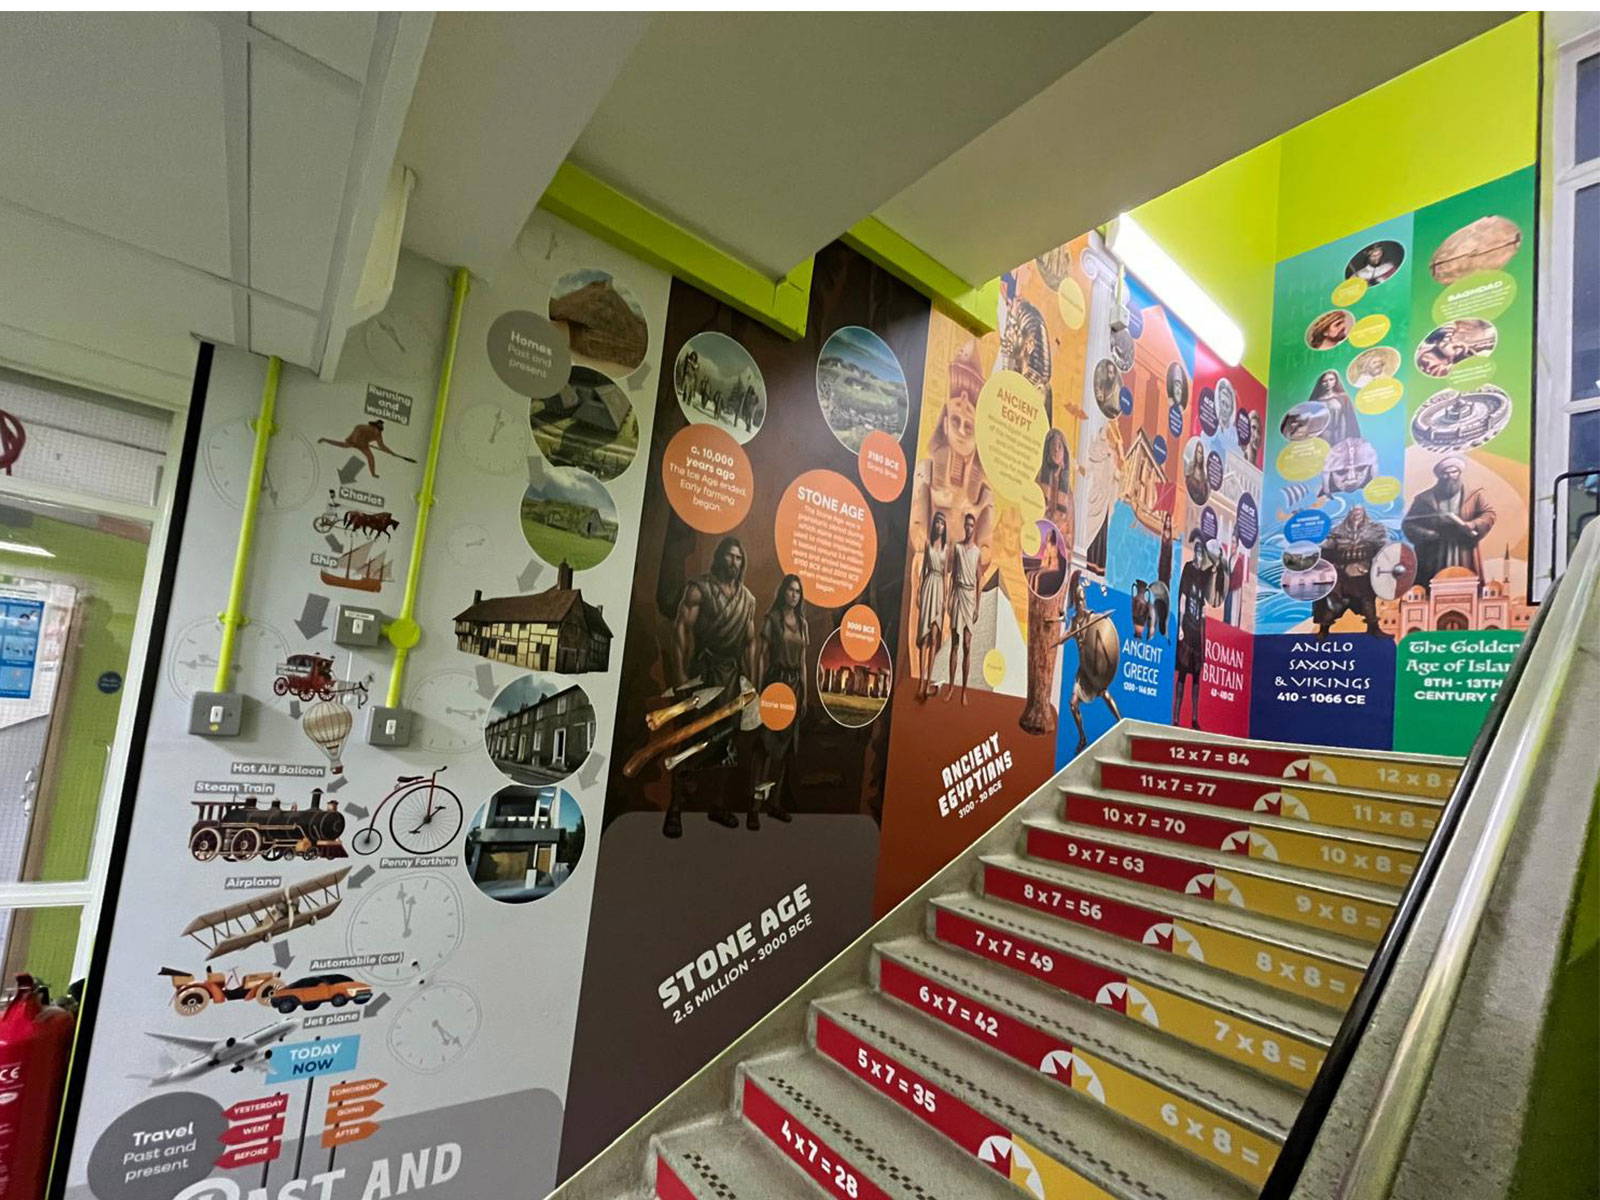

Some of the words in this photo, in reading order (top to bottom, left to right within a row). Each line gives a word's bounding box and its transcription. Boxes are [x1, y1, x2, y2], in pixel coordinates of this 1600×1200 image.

[511, 331, 552, 356] Homes
[509, 359, 547, 378] present
[378, 400, 399, 410] and
[996, 388, 1038, 421] ANCIENT
[1002, 406, 1032, 432] EGYPT
[686, 457, 714, 473] years
[716, 468, 735, 480] ago
[702, 448, 734, 467] 10,000
[669, 462, 685, 475] The
[687, 469, 700, 480] Ice
[701, 475, 718, 487] Age
[341, 488, 383, 505] Chariot
[680, 479, 702, 494] Early
[703, 486, 735, 506] farming
[797, 486, 839, 512] STONE
[840, 502, 865, 521] AGE
[312, 555, 337, 567] Ship
[1122, 639, 1163, 664] ANCIENT
[1205, 639, 1244, 669] ROMAN
[1291, 642, 1353, 653] ANGLO
[1409, 640, 1446, 653] The
[1123, 662, 1159, 685] GREECE
[1289, 659, 1355, 671] SAXONS
[1406, 659, 1440, 676] Age
[1443, 659, 1465, 672] of
[1202, 663, 1244, 691] BRITAIN
[1275, 676, 1288, 687] &
[1291, 676, 1370, 689] VIKINGS
[1424, 678, 1452, 687] 8TH
[1466, 678, 1503, 688] 13TH
[1277, 692, 1299, 702] 410
[1310, 693, 1342, 703] 1066
[1344, 694, 1366, 704] CE
[1414, 690, 1487, 702] CENTURY
[941, 731, 1000, 789] ANCIENT
[1169, 747, 1185, 759] 12
[1189, 750, 1198, 761] x
[1202, 750, 1211, 761] 7
[1228, 752, 1249, 766] 84
[232, 763, 255, 774] Hot
[259, 764, 276, 775] Air
[279, 766, 324, 776] Balloon
[1378, 768, 1400, 783] 12
[1427, 773, 1441, 787] 8
[196, 782, 240, 793] Steam
[244, 783, 274, 793] Train
[938, 750, 1013, 818] EGYPTIANS
[1140, 775, 1153, 787] 11
[1157, 779, 1167, 790] x
[1171, 779, 1180, 791] 7
[1197, 782, 1216, 796] 77
[958, 801, 975, 818] 3100
[988, 779, 1003, 797] BCE
[1103, 807, 1119, 822] 10
[1124, 813, 1133, 825] x
[1137, 813, 1147, 826] 7
[1164, 817, 1186, 834] 70
[1353, 804, 1372, 821] 11
[1400, 811, 1415, 828] 8
[381, 858, 413, 869] Penny
[415, 857, 457, 868] Farthing
[1067, 843, 1077, 857] 9
[1081, 850, 1091, 862] x
[1095, 849, 1105, 863] 7
[1122, 856, 1145, 873] 63
[1320, 845, 1346, 864] 10
[1375, 855, 1391, 872] 8
[226, 877, 280, 888] Airplane
[1024, 884, 1034, 899] 8
[1038, 890, 1048, 904] x
[1052, 892, 1061, 906] 7
[1079, 900, 1102, 920] 56
[1296, 895, 1312, 912] 9
[1341, 905, 1358, 925] 8
[657, 922, 757, 1010] STONE
[760, 883, 811, 937] AGE
[975, 929, 985, 946] 7
[988, 938, 999, 953] x
[1002, 940, 1013, 957] 7
[1030, 951, 1054, 972] 49
[311, 957, 376, 970] Automobile
[378, 952, 404, 964] (car)
[673, 1001, 694, 1024] 2.5
[694, 959, 749, 1008] MILLION
[757, 932, 788, 961] 3000
[788, 913, 813, 938] BCE
[1256, 951, 1272, 972] 8
[1304, 966, 1321, 987] 8
[304, 1016, 324, 1028] Jet
[325, 1012, 358, 1025] plane
[919, 986, 930, 1002] 6
[933, 994, 944, 1010] x
[947, 996, 957, 1016] 7
[974, 1011, 998, 1037] 42
[290, 1043, 341, 1061] TODAY
[1214, 1019, 1230, 1041] 7
[1237, 1033, 1254, 1054] x
[1262, 1040, 1281, 1063] 8
[292, 1058, 333, 1075] NOW
[331, 1082, 380, 1097] TOMORROW
[858, 1048, 868, 1069] 5
[871, 1058, 881, 1079] x
[885, 1063, 895, 1085] 7
[912, 1083, 936, 1113] 35
[234, 1099, 284, 1115] YESTERDAY
[337, 1106, 365, 1116] GOING
[133, 1122, 194, 1146] Travel
[242, 1124, 269, 1135] WENT
[335, 1127, 360, 1138] AFTER
[1160, 1103, 1179, 1127] 6
[1186, 1118, 1205, 1141] x
[1213, 1127, 1232, 1154] 8
[123, 1150, 160, 1165] Past
[164, 1139, 197, 1156] and
[234, 1147, 269, 1161] BEFORE
[781, 1120, 792, 1142] 4
[794, 1132, 805, 1156] x
[808, 1140, 818, 1163] 7
[835, 1164, 858, 1199] 28
[124, 1158, 189, 1183] present
[361, 1142, 462, 1200] AND
